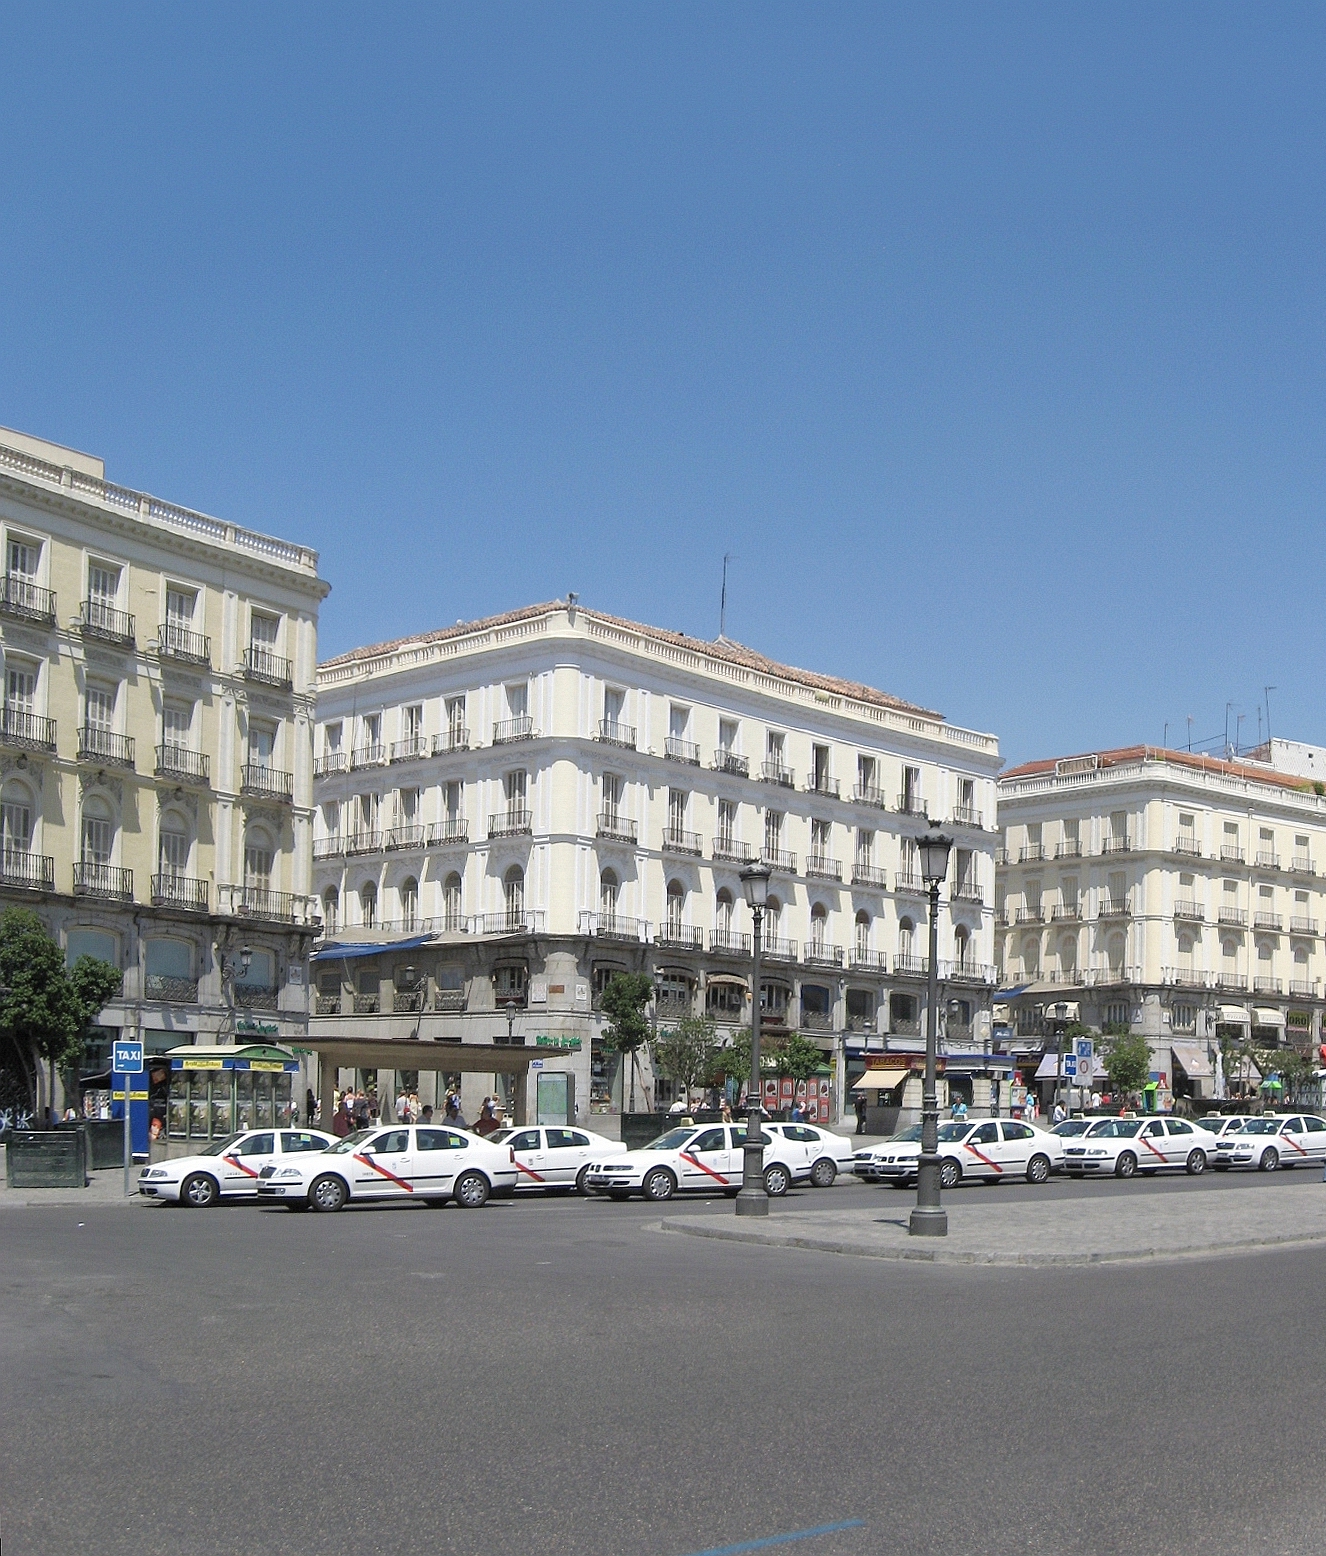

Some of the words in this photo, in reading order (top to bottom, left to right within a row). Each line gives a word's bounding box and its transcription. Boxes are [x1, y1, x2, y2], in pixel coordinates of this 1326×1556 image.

[1289, 1016, 1307, 1026] ORO
[116, 1050, 141, 1061] TAXI
[872, 1057, 906, 1066] TABACOS
